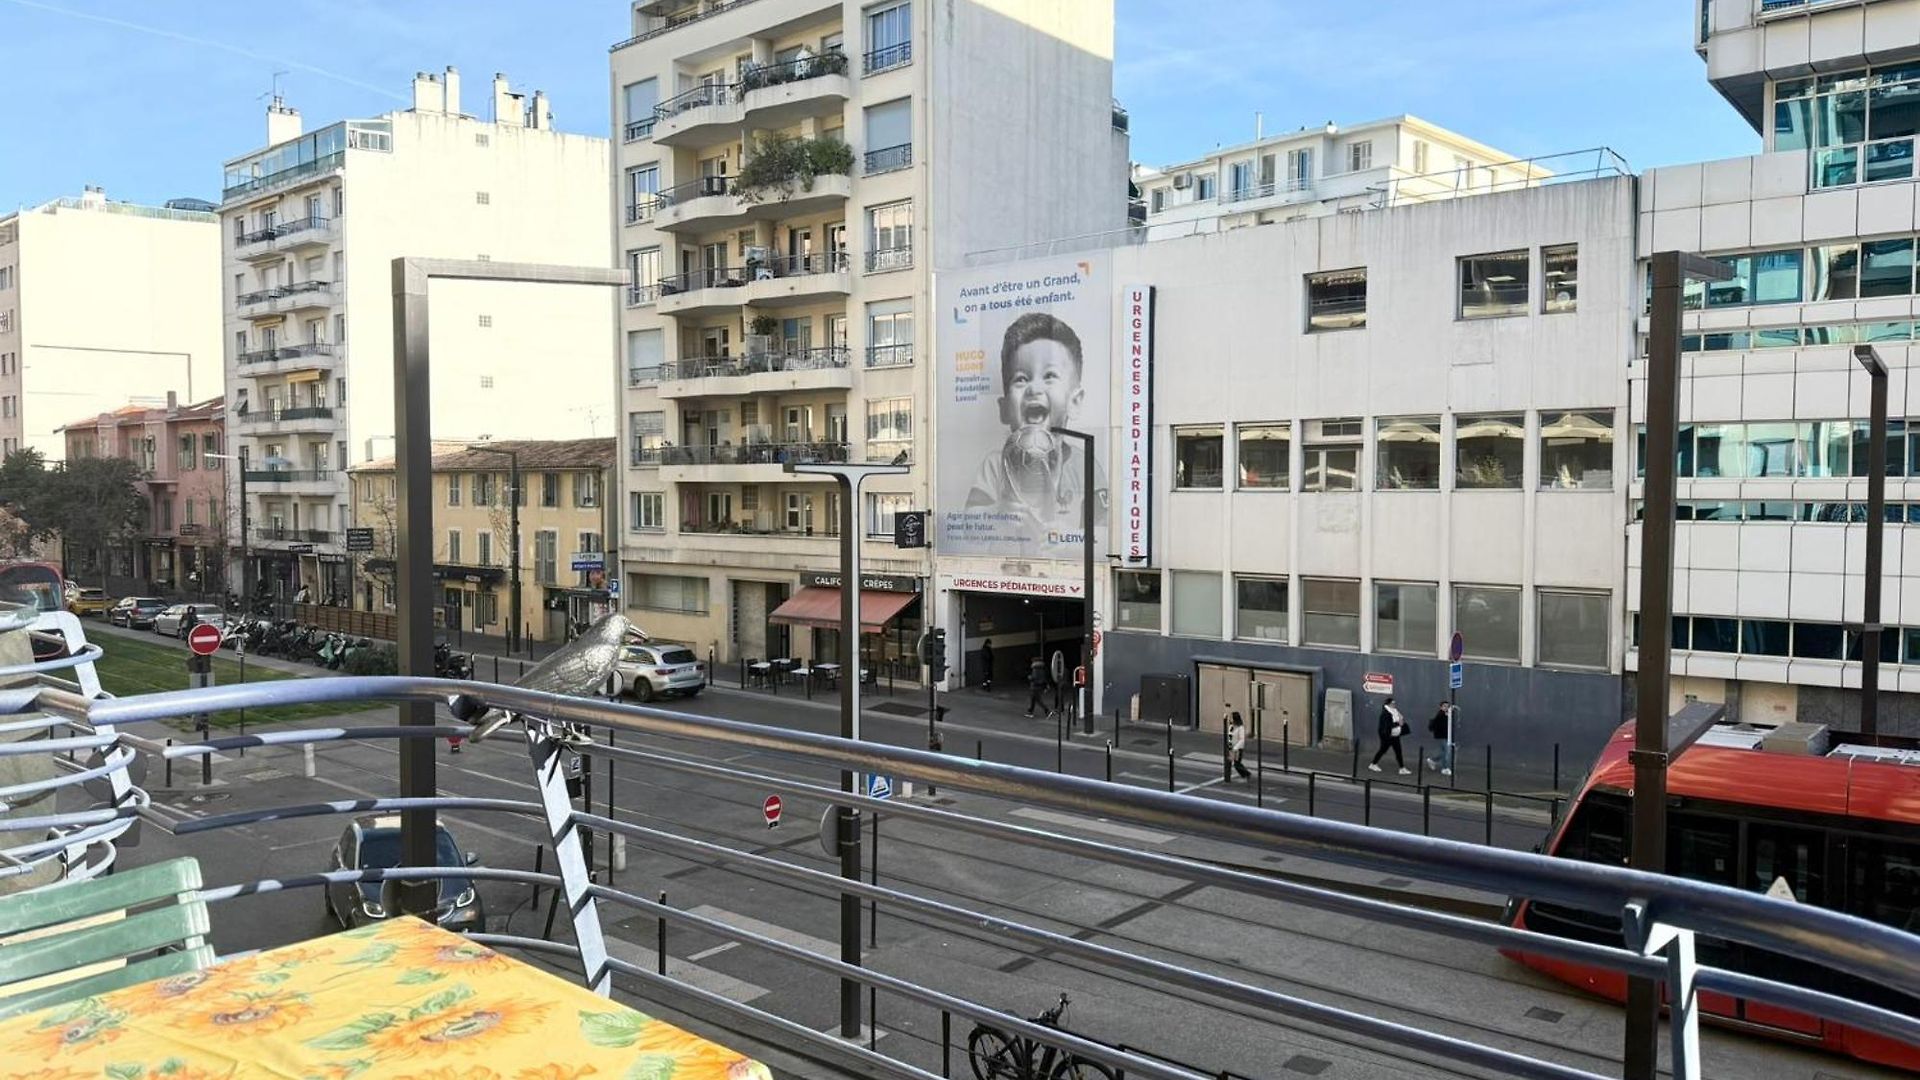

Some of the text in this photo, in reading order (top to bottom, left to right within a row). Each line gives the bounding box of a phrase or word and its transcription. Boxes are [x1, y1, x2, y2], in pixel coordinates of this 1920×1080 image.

[960, 272, 1082, 298] Avant d'être un Grand,
[964, 291, 1075, 313] on a tous été enfant.
[1132, 291, 1142, 395] URGENCES
[1130, 402, 1141, 556] PEDIATRIQUES
[953, 578, 1066, 593] URGENCES PÉDIATRIQUES
